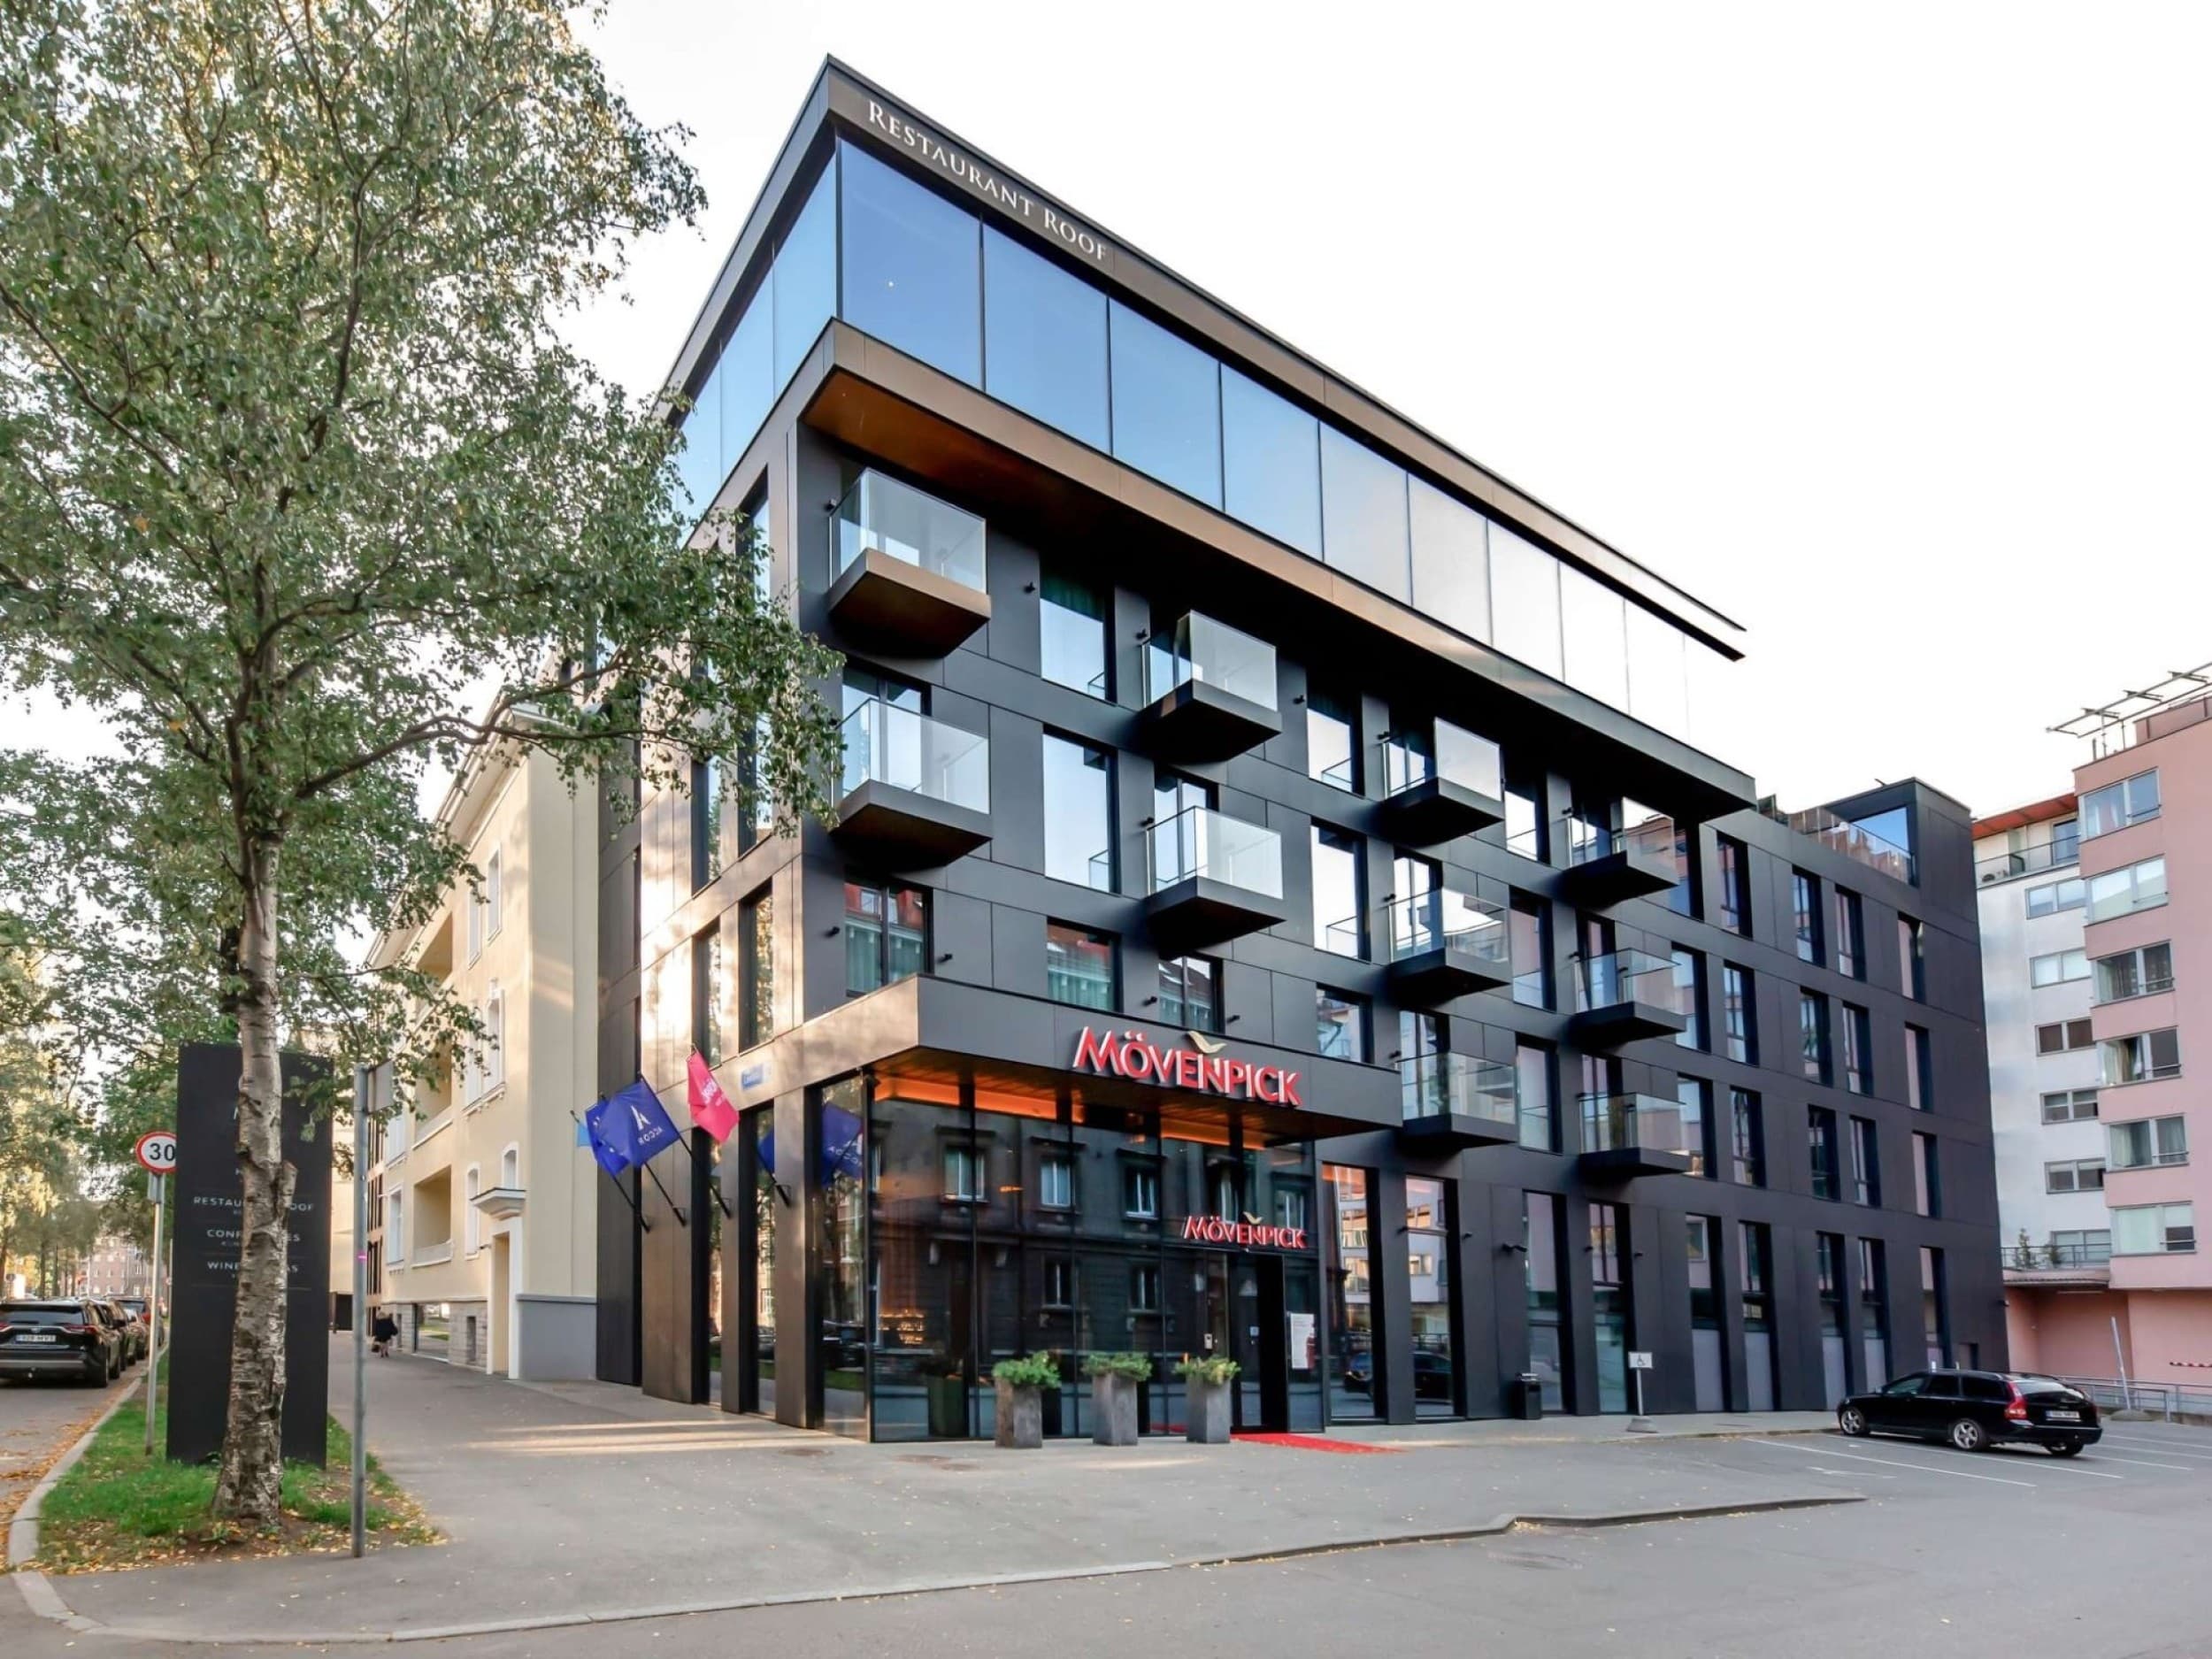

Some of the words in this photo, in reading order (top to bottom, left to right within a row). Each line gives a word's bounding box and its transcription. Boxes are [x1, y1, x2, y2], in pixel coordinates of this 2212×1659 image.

[868, 100, 1034, 217] RESTAURANT
[1043, 208, 1107, 260] ROOF
[1072, 1025, 1303, 1106] MÖVENPICK
[150, 1142, 175, 1162] 30
[1183, 1215, 1306, 1248] MÖVENPICK
